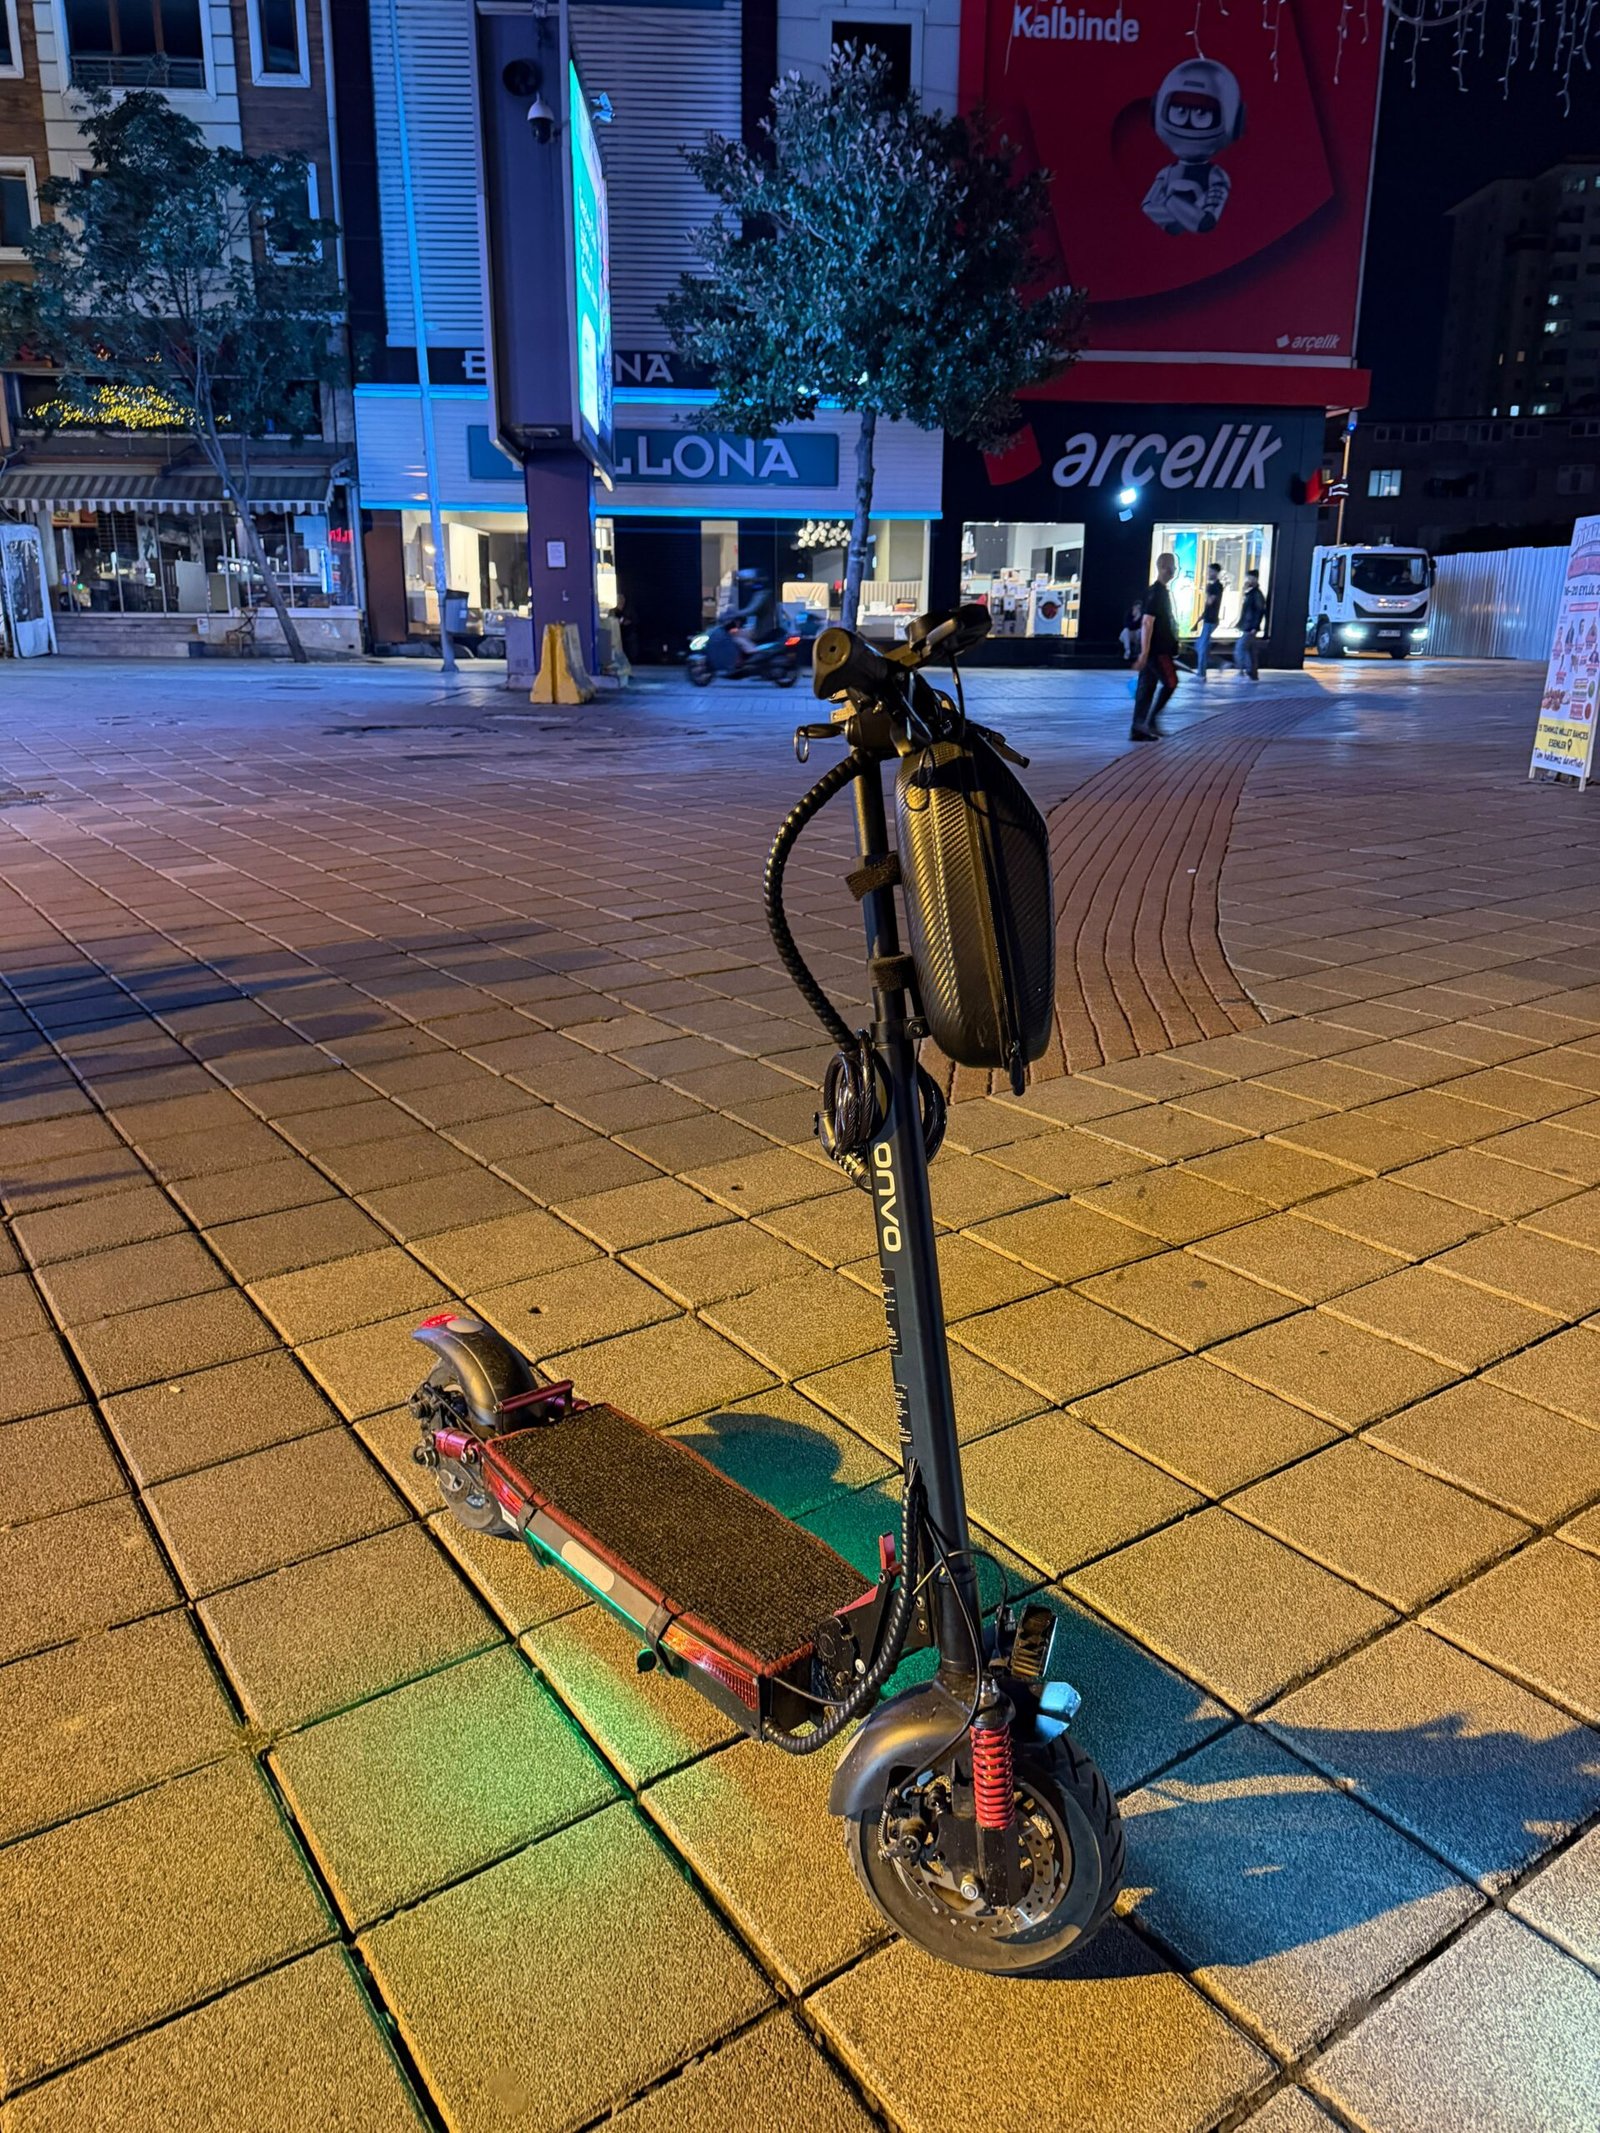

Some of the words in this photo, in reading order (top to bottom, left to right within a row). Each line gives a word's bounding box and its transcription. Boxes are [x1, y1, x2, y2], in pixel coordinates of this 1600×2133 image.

[1013, 4, 1140, 43] Kalbinde
[1291, 334, 1341, 352] arçelik
[874, 1142, 902, 1252] onvo
